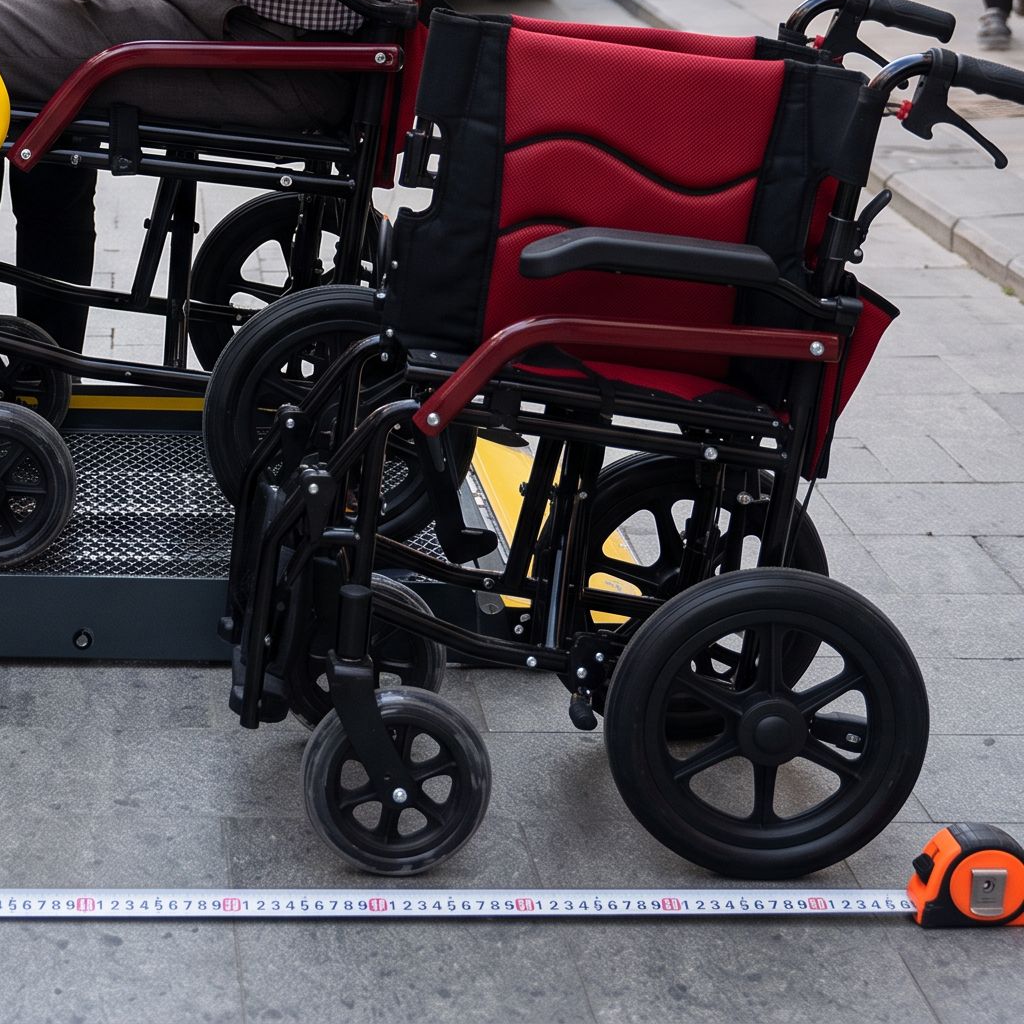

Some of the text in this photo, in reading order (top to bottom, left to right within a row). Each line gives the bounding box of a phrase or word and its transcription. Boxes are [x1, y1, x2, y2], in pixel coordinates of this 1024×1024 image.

[8, 899, 17, 911] 5
[22, 899, 32, 910] 6
[37, 900, 47, 910] 7
[51, 899, 61, 911] 8
[65, 899, 76, 910] 9
[96, 899, 103, 910] 1
[110, 900, 120, 911] 2
[125, 899, 135, 911] 3
[139, 900, 149, 911] 4
[154, 899, 163, 911] 5
[168, 899, 178, 911] 6
[183, 900, 193, 911] 7
[197, 900, 207, 911] 8
[211, 899, 222, 911] 9
[242, 900, 249, 911] 1
[256, 900, 266, 911] 2
[271, 900, 281, 911] 3
[285, 900, 296, 911] 4
[300, 899, 310, 912] 5
[314, 900, 325, 911] 6
[329, 900, 338, 911] 7
[343, 900, 354, 911] 8
[357, 900, 368, 911] 9
[389, 900, 396, 911] 1
[402, 900, 413, 911] 2
[417, 900, 428, 911] 3
[431, 900, 443, 911] 4
[447, 900, 457, 912] 5
[461, 900, 472, 911] 6
[475, 900, 485, 911] 7
[490, 900, 501, 911] 8
[535, 900, 543, 911] 1
[549, 900, 560, 911] 2
[563, 900, 574, 911] 3
[578, 900, 590, 911] 4
[593, 899, 603, 912] 5
[607, 900, 618, 911] 6
[622, 900, 632, 911] 7
[636, 900, 647, 911] 8
[650, 900, 662, 911] 9
[681, 900, 690, 911] 1
[695, 900, 706, 910] 2
[710, 899, 721, 910] 3
[724, 900, 736, 910] 4
[753, 899, 765, 910] 6
[767, 899, 778, 910] 7
[783, 899, 794, 910] 8
[797, 899, 808, 910] 9
[828, 899, 836, 910] 1
[841, 899, 852, 910] 2
[855, 899, 867, 910] 3
[871, 899, 882, 910] 4
[884, 899, 896, 911] 5
